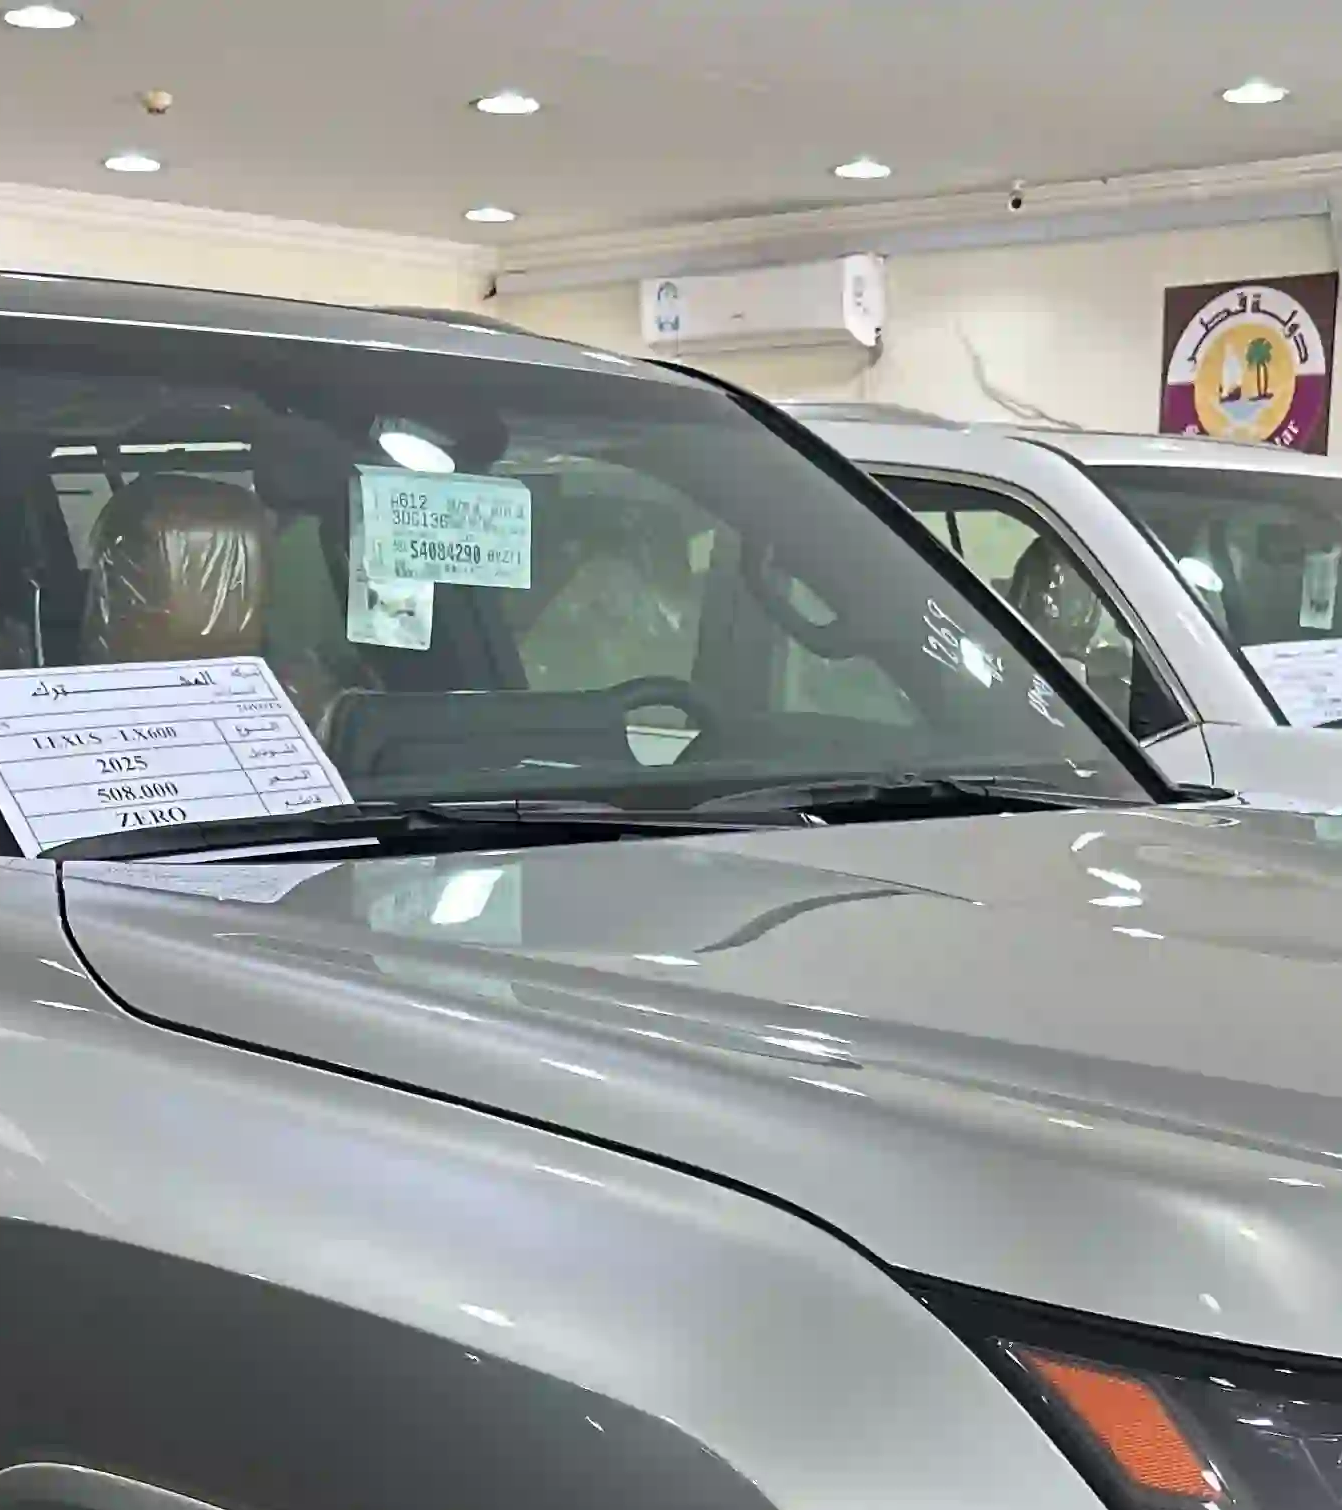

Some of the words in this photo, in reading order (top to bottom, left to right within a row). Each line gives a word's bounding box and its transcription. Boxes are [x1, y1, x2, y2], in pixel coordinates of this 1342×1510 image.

[32, 732, 103, 750] LEXUS
[95, 754, 149, 774] 2025
[96, 780, 179, 804] 508.000
[115, 805, 188, 828] ZERO
